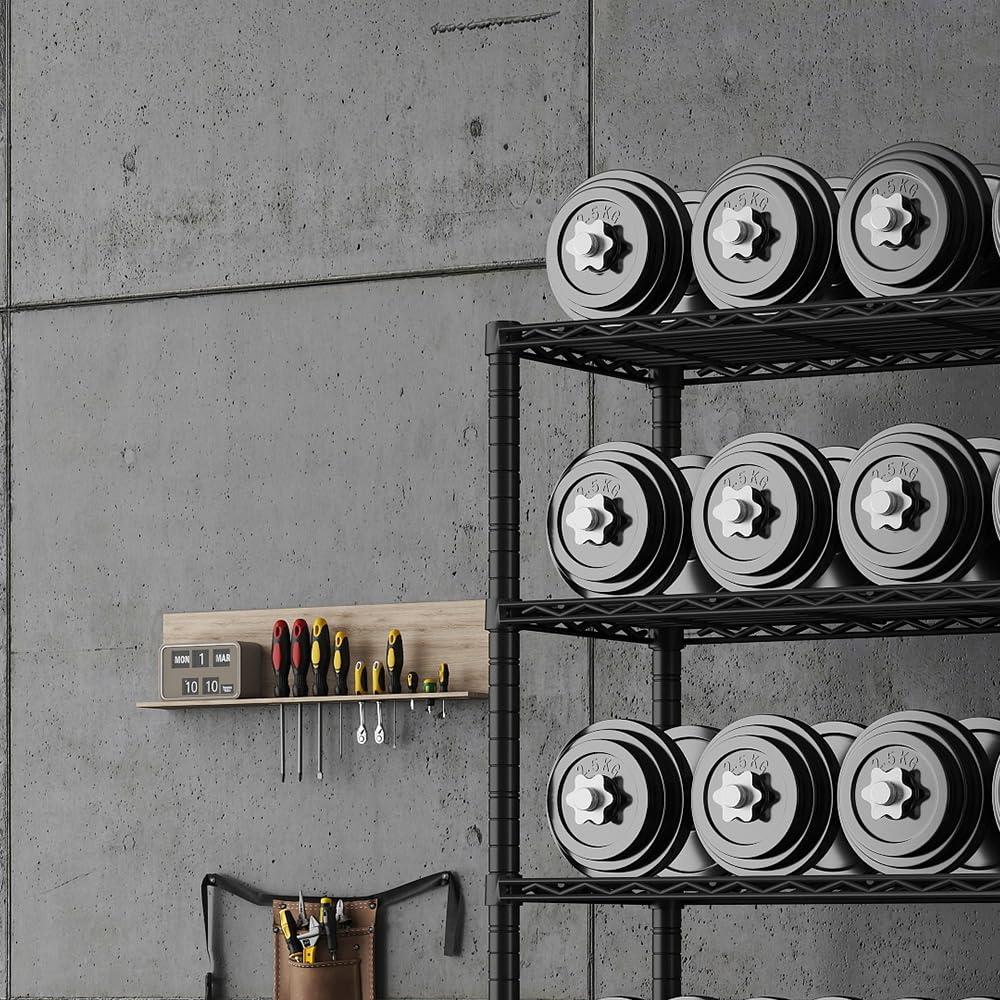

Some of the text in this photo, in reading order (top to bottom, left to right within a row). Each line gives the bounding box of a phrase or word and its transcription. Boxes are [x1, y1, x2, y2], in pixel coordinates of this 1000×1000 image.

[174, 652, 231, 665] MON 1 MAR
[185, 680, 198, 693] 10
[206, 680, 218, 693] 10
